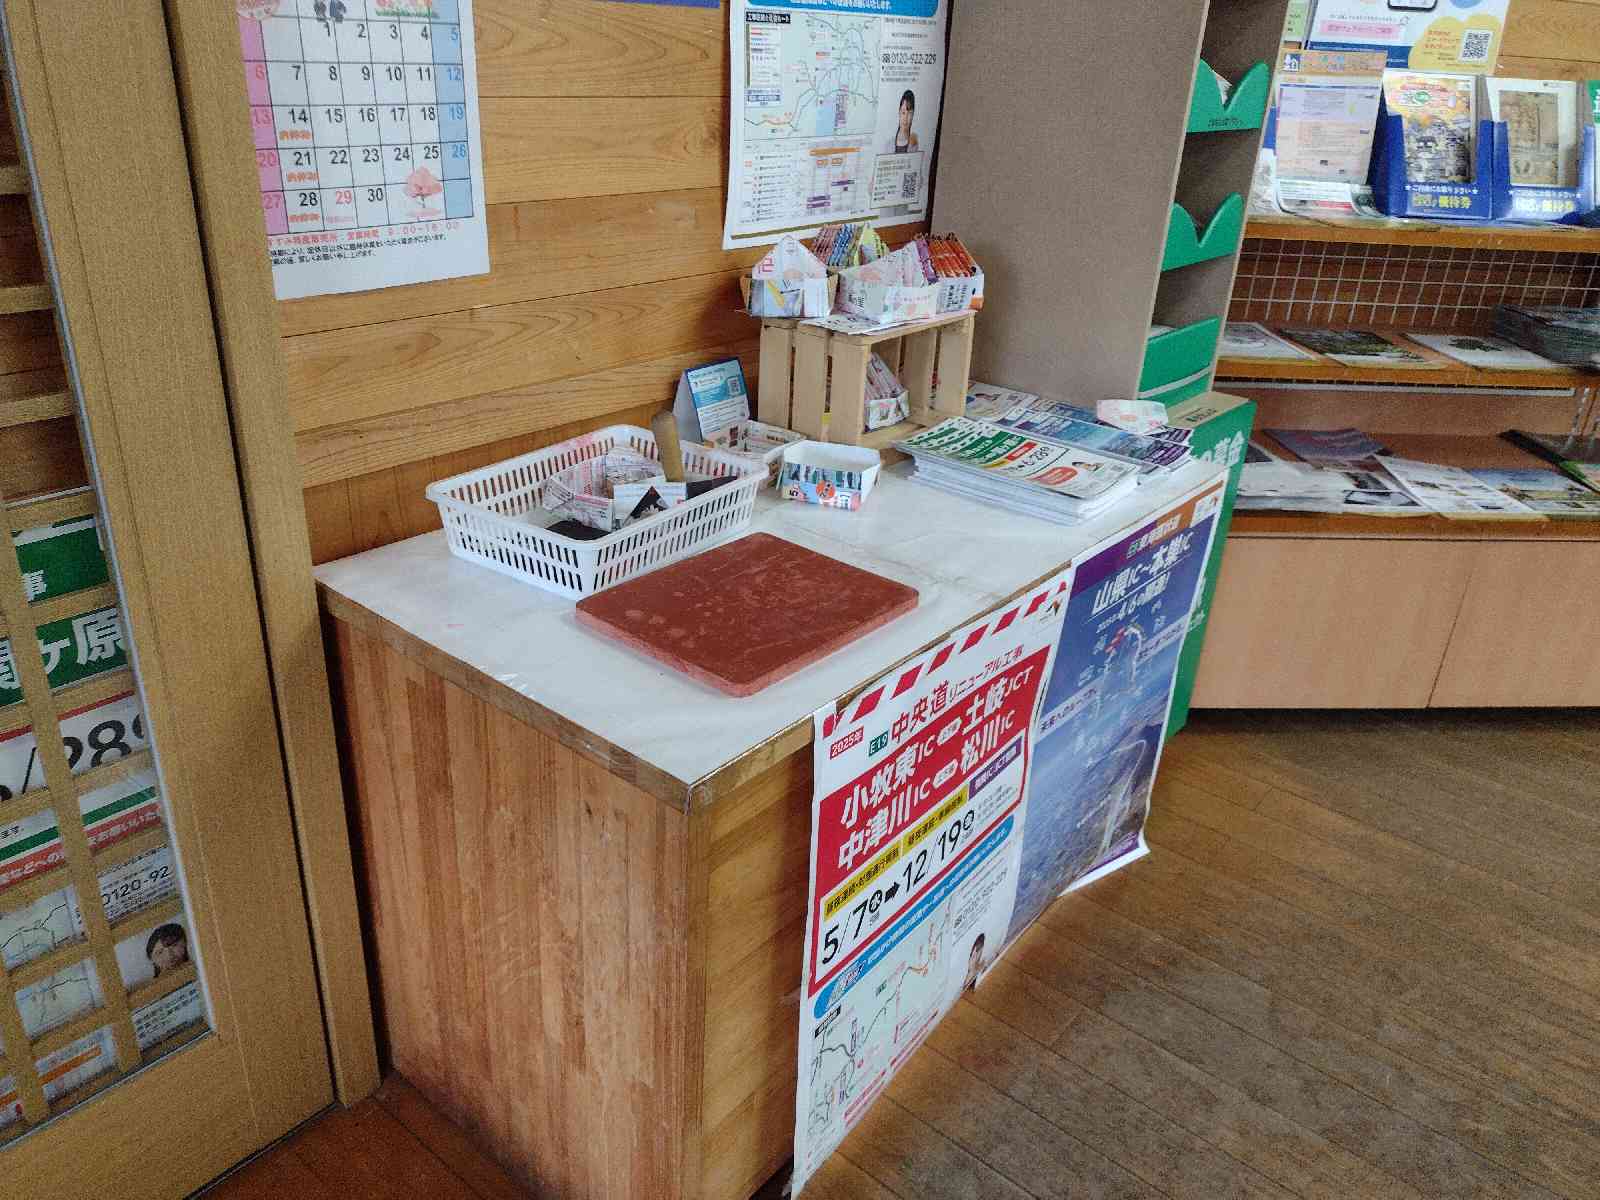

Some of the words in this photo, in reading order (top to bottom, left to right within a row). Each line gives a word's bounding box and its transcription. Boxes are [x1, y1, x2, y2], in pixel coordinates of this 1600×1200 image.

[324, 23, 332, 37] 1
[357, 24, 367, 39] 2
[390, 24, 399, 39] 3
[420, 24, 430, 39] 4
[291, 65, 302, 81] 7
[329, 65, 338, 81] 8
[361, 66, 371, 81] 9
[385, 66, 403, 81] 10
[416, 66, 432, 81] 11
[288, 109, 309, 124] 14
[325, 109, 344, 124] 15
[358, 108, 376, 122] 16
[390, 107, 406, 122] 17
[421, 106, 436, 121] 18
[449, 106, 464, 120] 19
[293, 151, 312, 166] 21
[330, 149, 349, 164] 22
[362, 148, 380, 163] 23
[394, 147, 410, 161] 24
[424, 145, 440, 160] 25
[451, 143, 467, 158] 26
[299, 192, 318, 207] 28
[335, 189, 353, 205] 29
[367, 187, 384, 202] 30
[869, 732, 888, 756] E19
[838, 778, 931, 869] 中津川IC
[960, 710, 1016, 775] 松川IC
[841, 732, 936, 829] 小牧東IC
